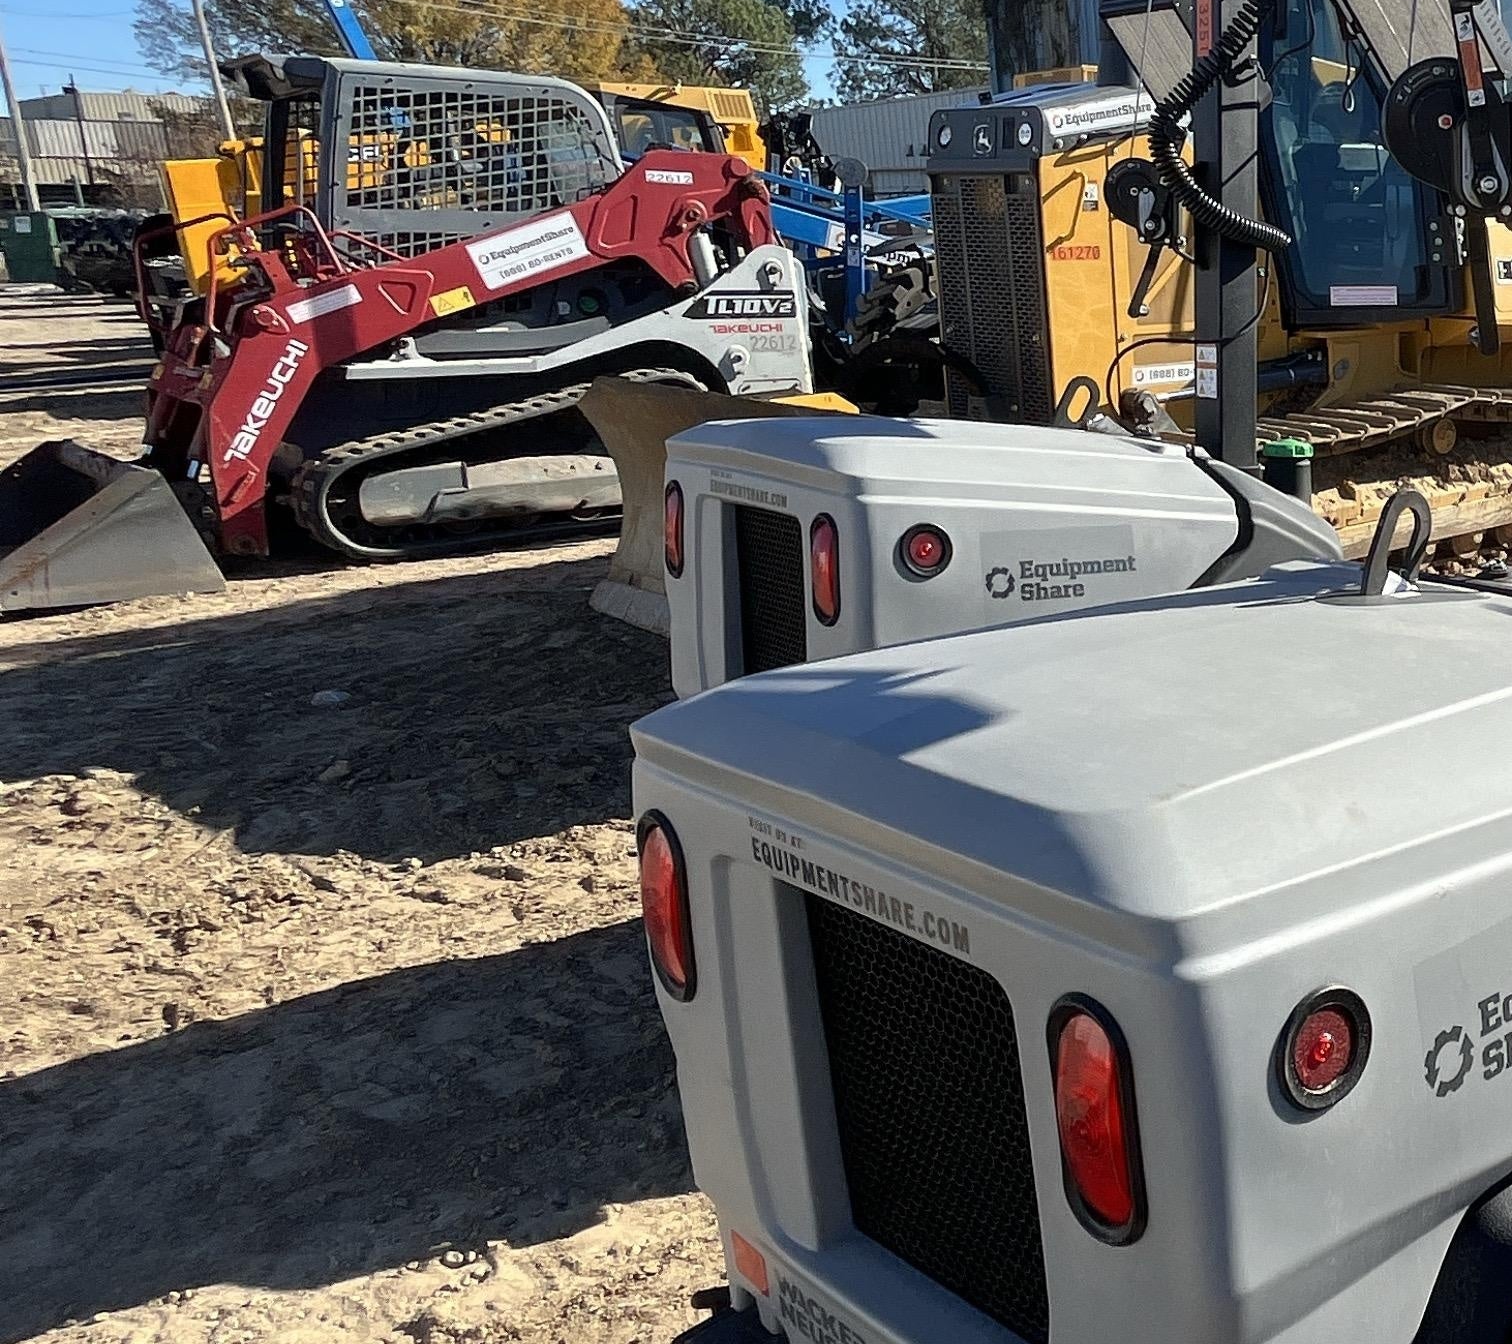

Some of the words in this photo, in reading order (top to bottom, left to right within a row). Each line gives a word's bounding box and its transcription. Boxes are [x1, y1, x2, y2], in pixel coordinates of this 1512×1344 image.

[1065, 103, 1152, 126] EquipmentShare
[489, 226, 575, 261] EquipmentShare
[749, 335, 797, 352] 22612
[1019, 555, 1137, 582] Equipment
[1020, 582, 1086, 602] Share
[751, 836, 971, 955] EQUIPMENTSHARE.COM
